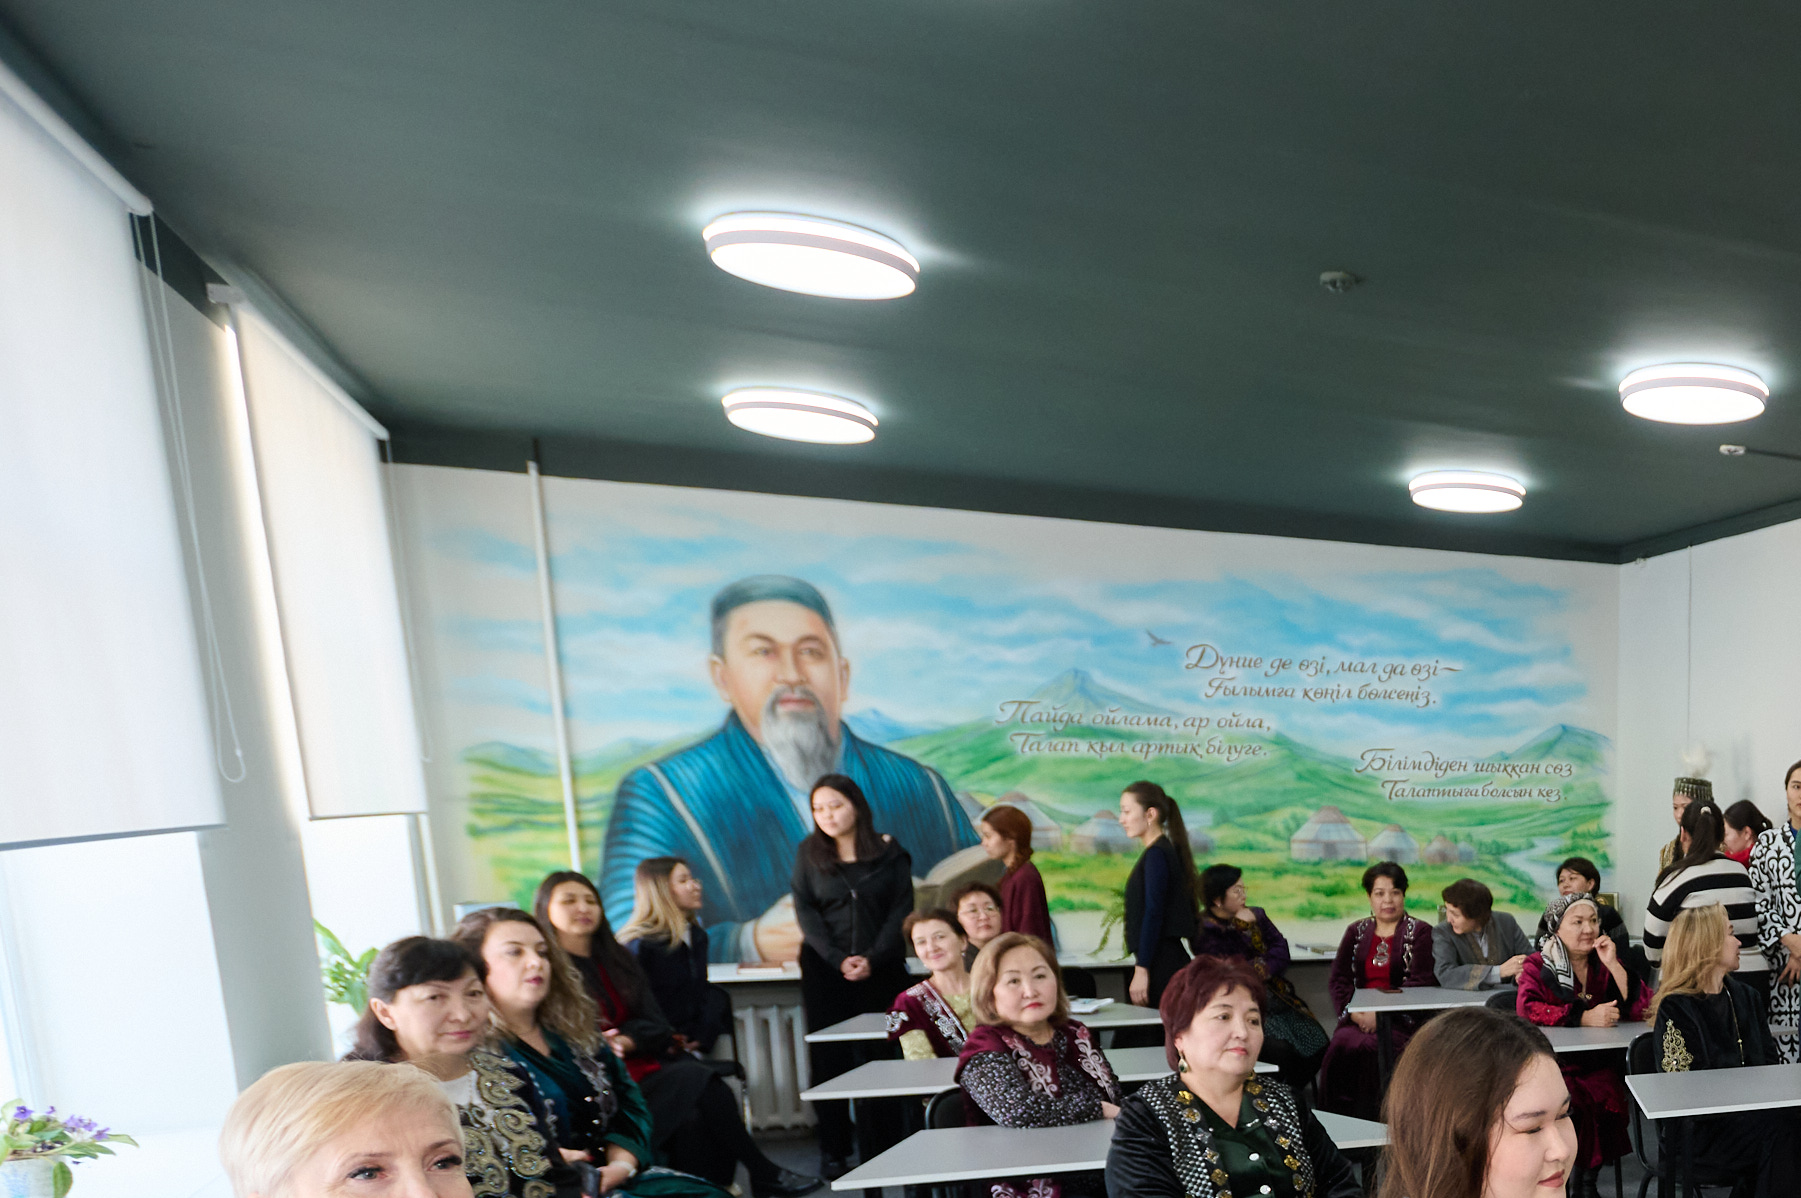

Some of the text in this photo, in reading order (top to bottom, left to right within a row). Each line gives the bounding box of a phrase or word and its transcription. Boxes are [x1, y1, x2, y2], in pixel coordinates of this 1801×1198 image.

[1185, 643, 1263, 675] Дүние
[1264, 658, 1292, 677] де
[1298, 656, 1331, 677] өзі,
[1333, 660, 1378, 674] мал
[1378, 663, 1407, 682] да
[995, 700, 1271, 736] Пайда ойлама, ар ойла,
[1009, 732, 1079, 754] Талап
[1205, 736, 1268, 763] білуге.
[1354, 748, 1572, 778] Білімдіден шыққан сөз
